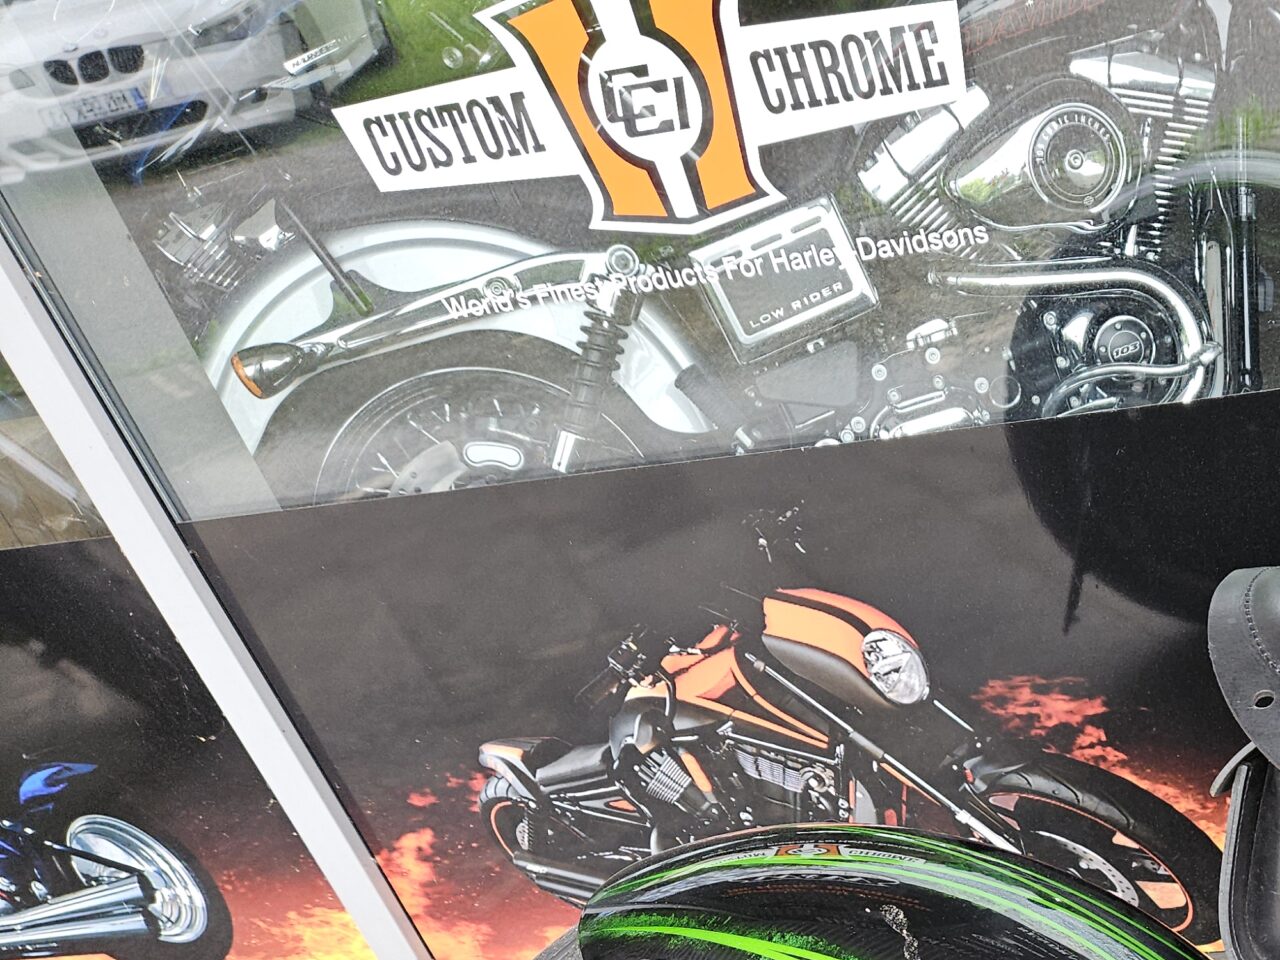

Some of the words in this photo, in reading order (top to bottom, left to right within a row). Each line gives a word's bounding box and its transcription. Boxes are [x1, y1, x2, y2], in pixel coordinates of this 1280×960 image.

[750, 20, 950, 115] CHROME
[363, 91, 546, 176] CUSTOM
[1074, 114, 1111, 140] INCHES
[443, 287, 532, 320] World's
[534, 275, 606, 308] Finest
[611, 260, 719, 296] Products
[722, 253, 764, 281] For
[750, 307, 785, 328] LOW
[791, 281, 844, 310] RIDER
[1112, 341, 1140, 360] 103
